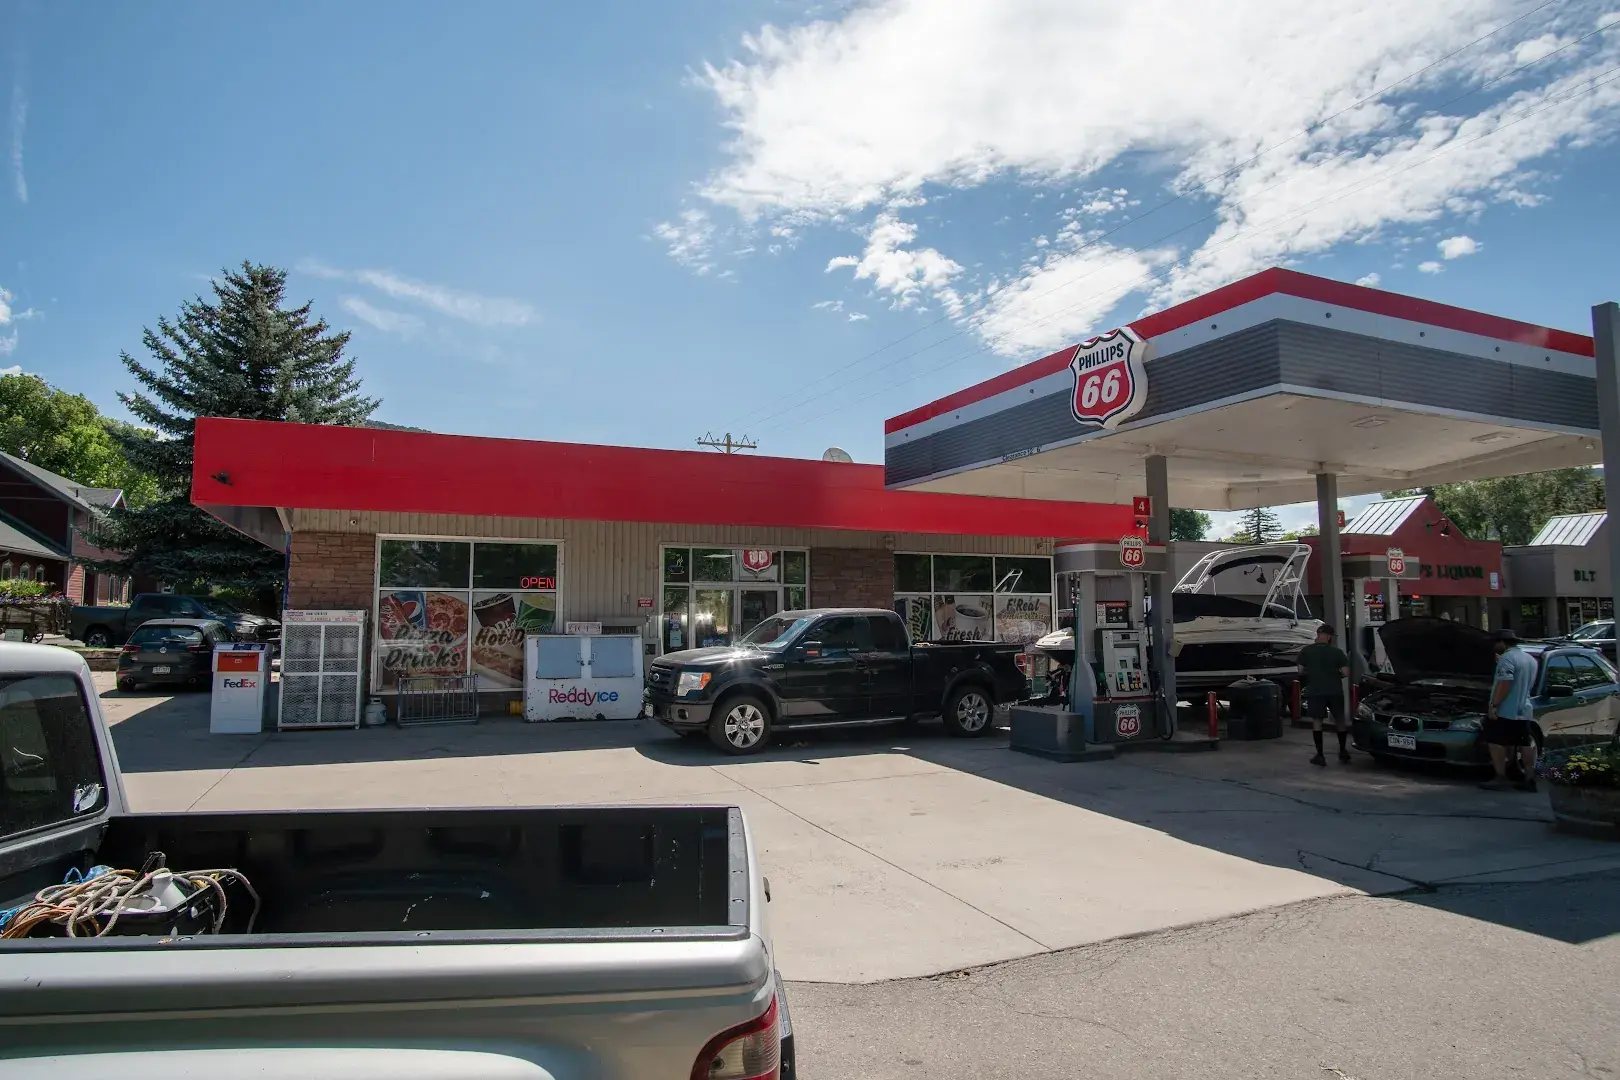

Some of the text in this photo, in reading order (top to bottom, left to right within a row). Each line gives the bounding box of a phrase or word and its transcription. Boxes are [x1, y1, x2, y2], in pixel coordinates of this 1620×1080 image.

[1078, 342, 1124, 371] PHILLIPS
[1081, 368, 1122, 409] 66
[1138, 501, 1146, 512] 4
[1337, 514, 1343, 524] 2
[1124, 549, 1141, 562] 66
[1390, 560, 1402, 570] 66
[1573, 569, 1597, 582] BLT
[521, 577, 555, 589] OPEN
[946, 626, 982, 641] Fresh
[385, 646, 462, 668] Drinks
[223, 678, 256, 689] FedEx
[1120, 718, 1136, 731] 66
